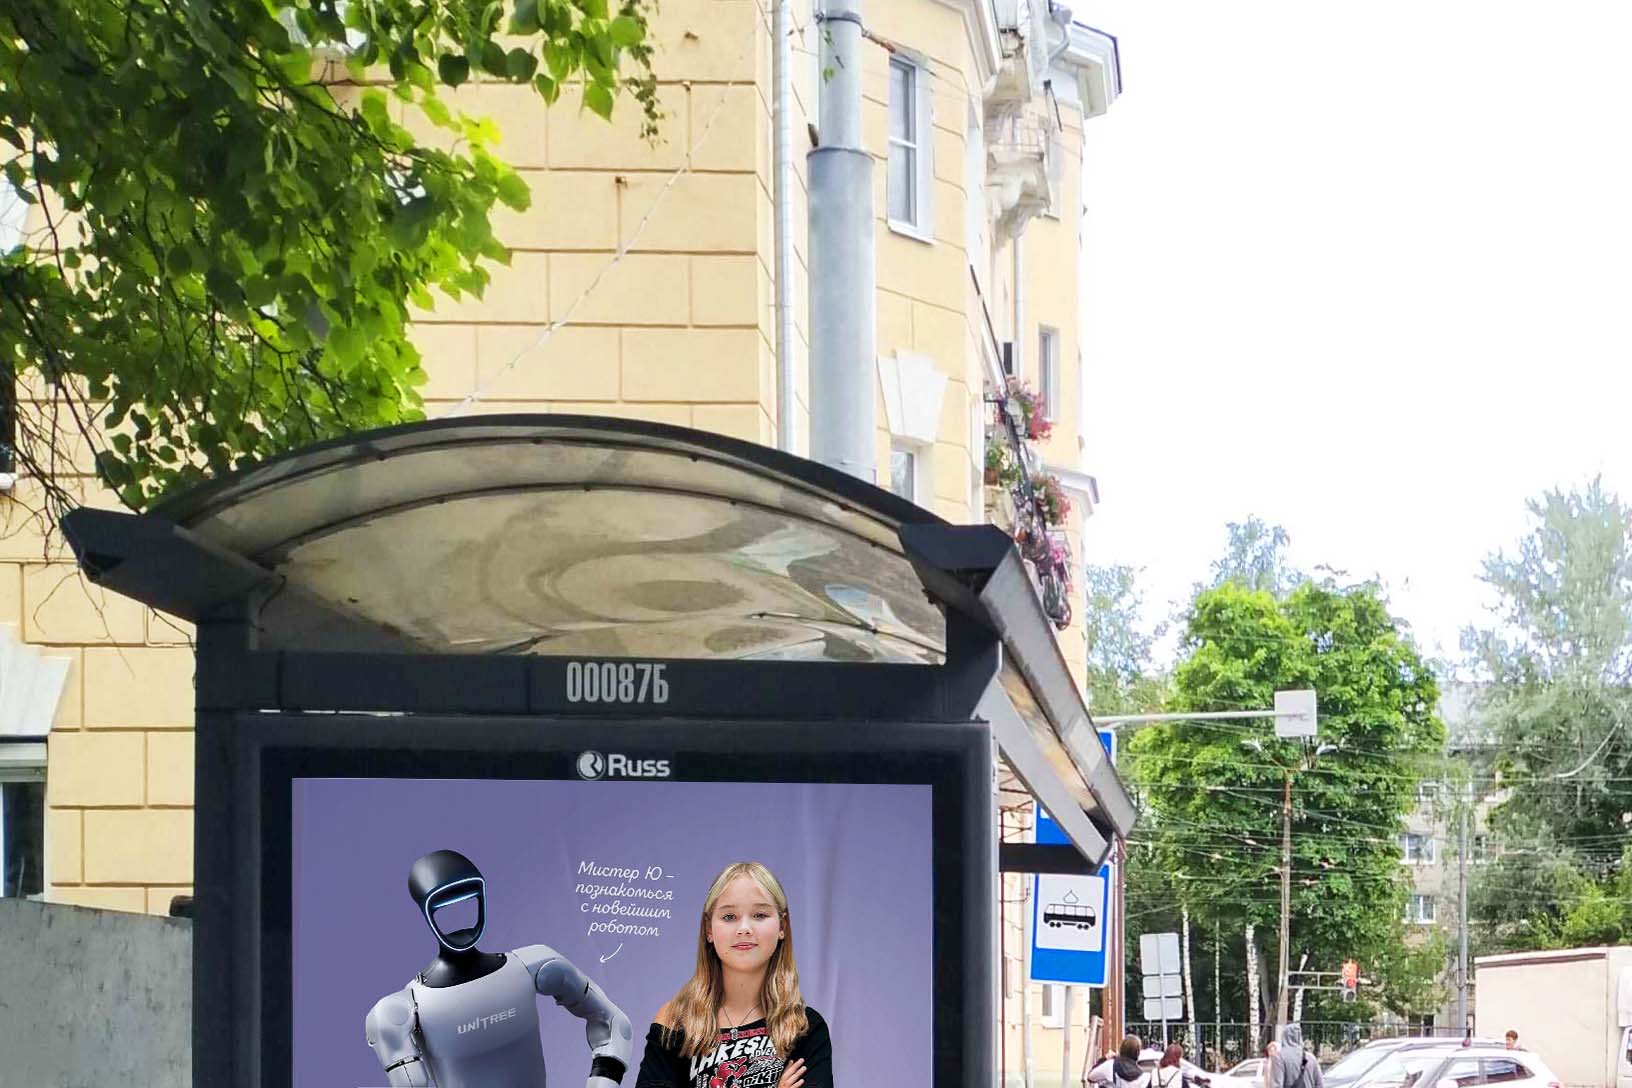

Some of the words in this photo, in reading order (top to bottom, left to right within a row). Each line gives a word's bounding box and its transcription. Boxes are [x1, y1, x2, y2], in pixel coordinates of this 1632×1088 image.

[607, 753, 671, 777] Russ
[577, 860, 639, 882] Мистер
[644, 864, 663, 881] Ю
[575, 883, 674, 902] познакомься
[580, 902, 589, 913] с
[592, 901, 672, 919] новейшим
[587, 918, 660, 937] роботом
[457, 1007, 517, 1034] UNITREE
